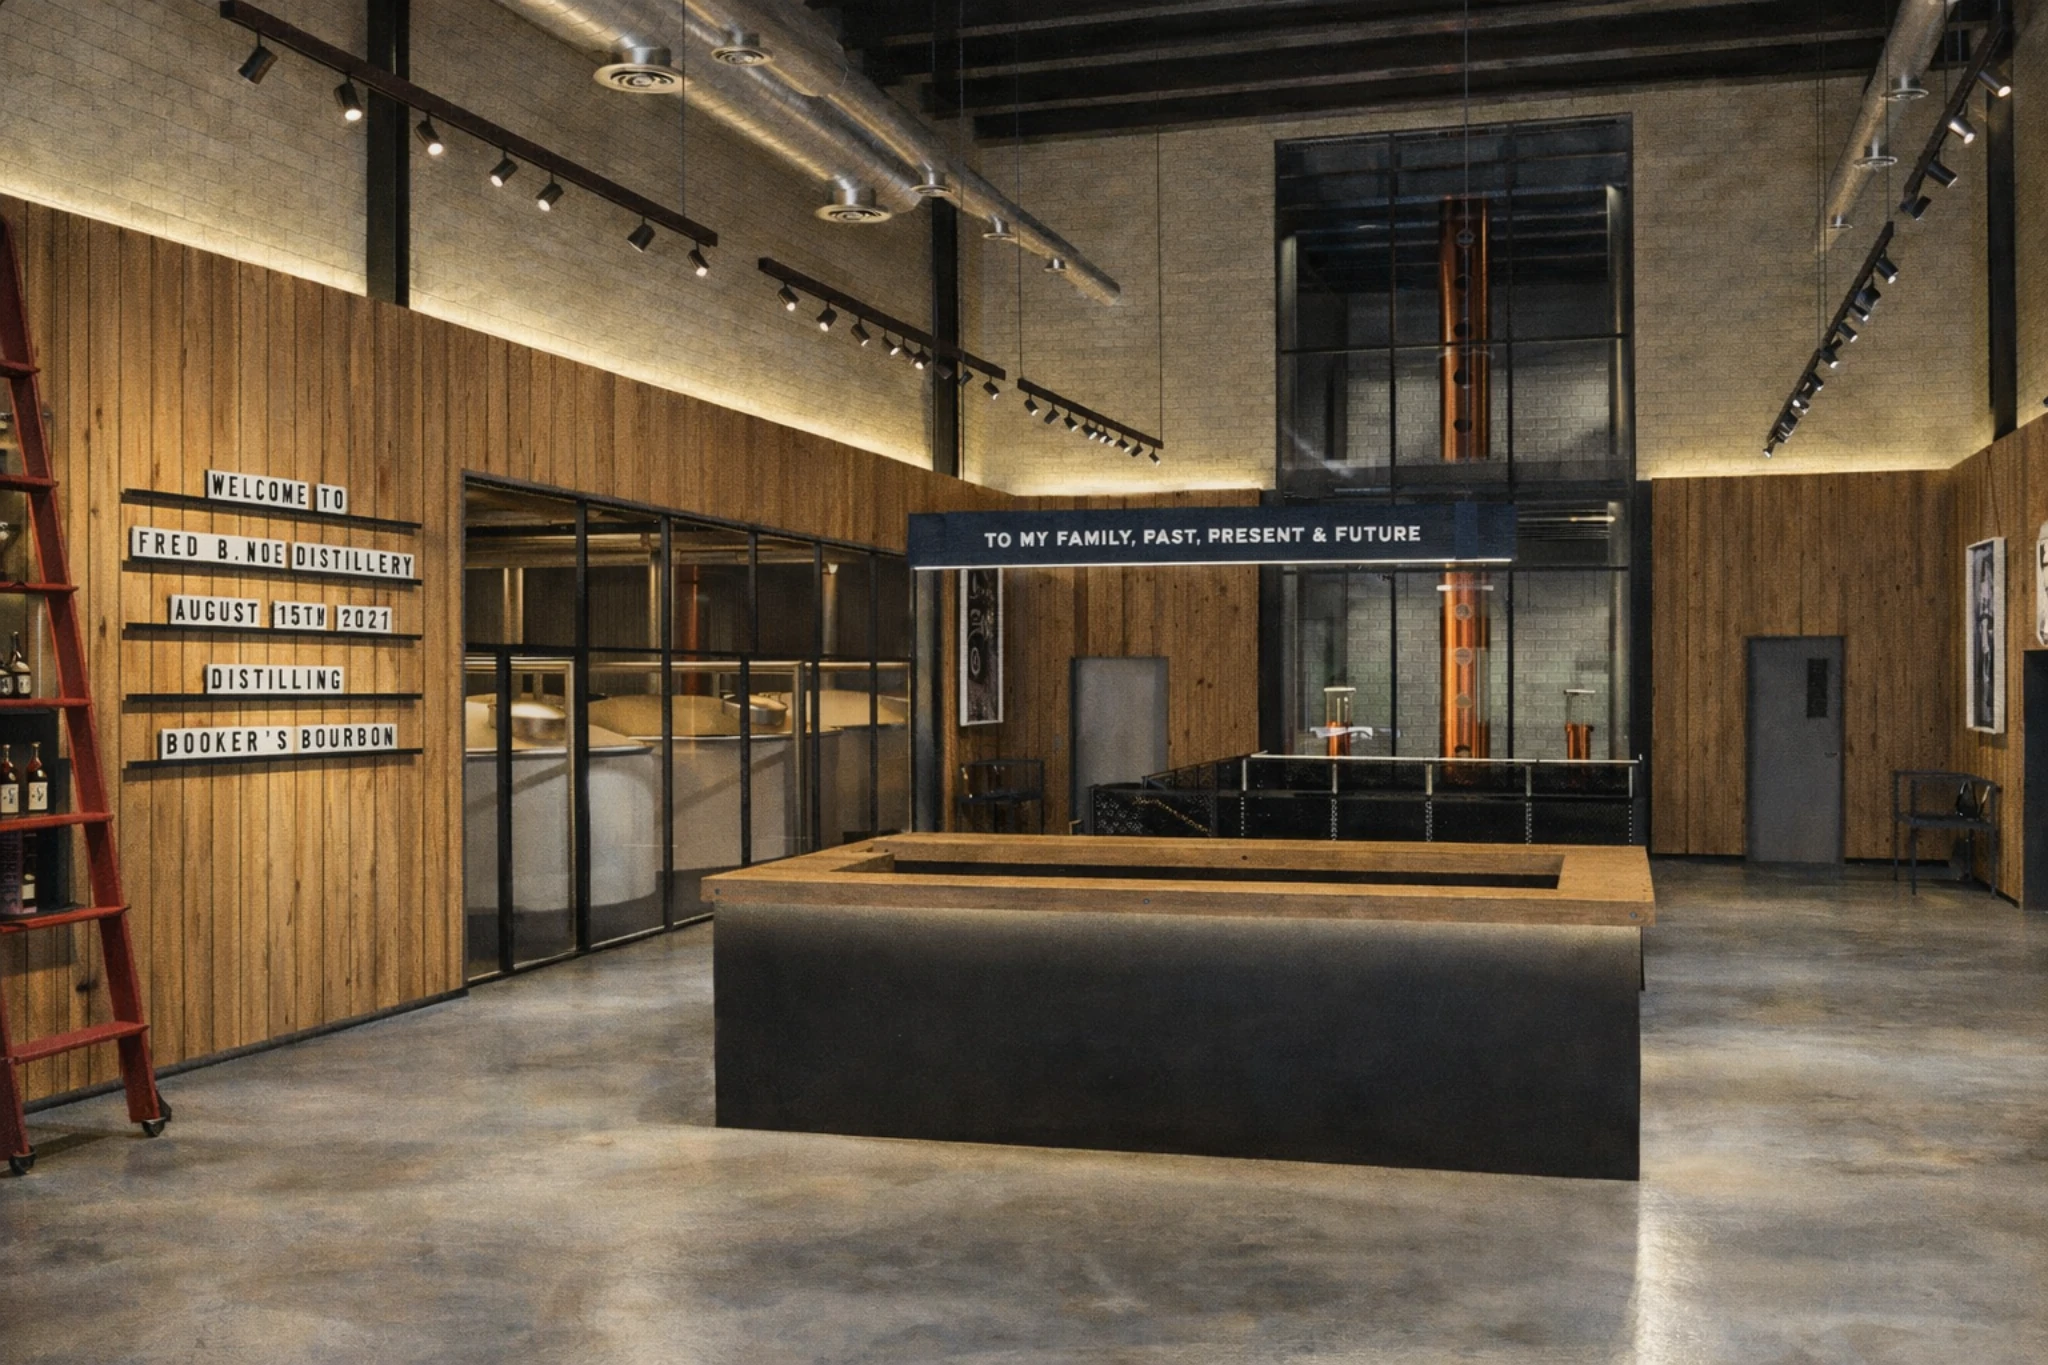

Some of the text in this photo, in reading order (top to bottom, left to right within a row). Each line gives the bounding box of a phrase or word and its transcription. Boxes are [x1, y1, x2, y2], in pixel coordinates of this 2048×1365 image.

[212, 474, 344, 509] WELCOME TO
[984, 525, 1421, 548] TO MY FAMILY, PAST, PRESENT & FUTURE
[139, 531, 198, 557] FRED
[296, 546, 412, 576] DISTILLERY
[175, 599, 389, 630] AUGUST 15TH 2021
[211, 668, 341, 690] DISTILLING
[166, 726, 394, 754] BOOKER'S BOURBON
